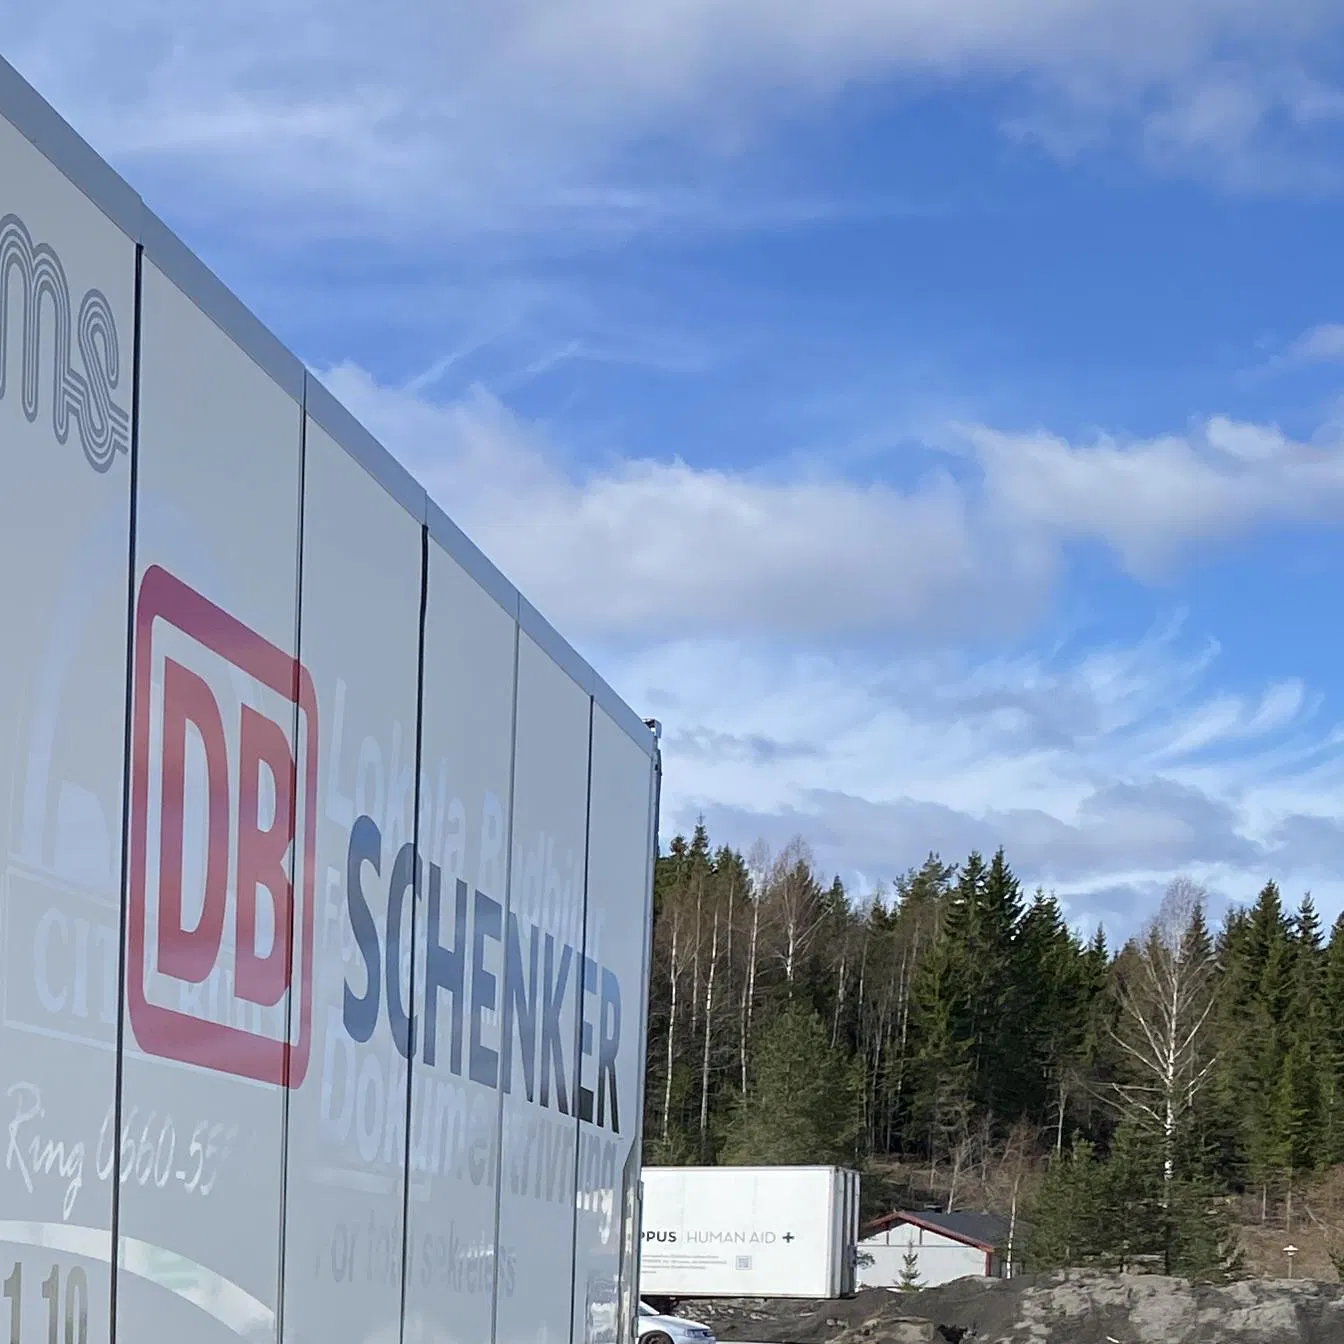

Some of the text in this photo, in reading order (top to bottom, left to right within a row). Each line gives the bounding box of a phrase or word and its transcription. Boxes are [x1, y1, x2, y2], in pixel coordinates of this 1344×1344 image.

[157, 656, 296, 1008] DB
[343, 814, 619, 1134] SCHENKER
[687, 1231, 746, 1244] HUMAN
[749, 1231, 777, 1244] AID
